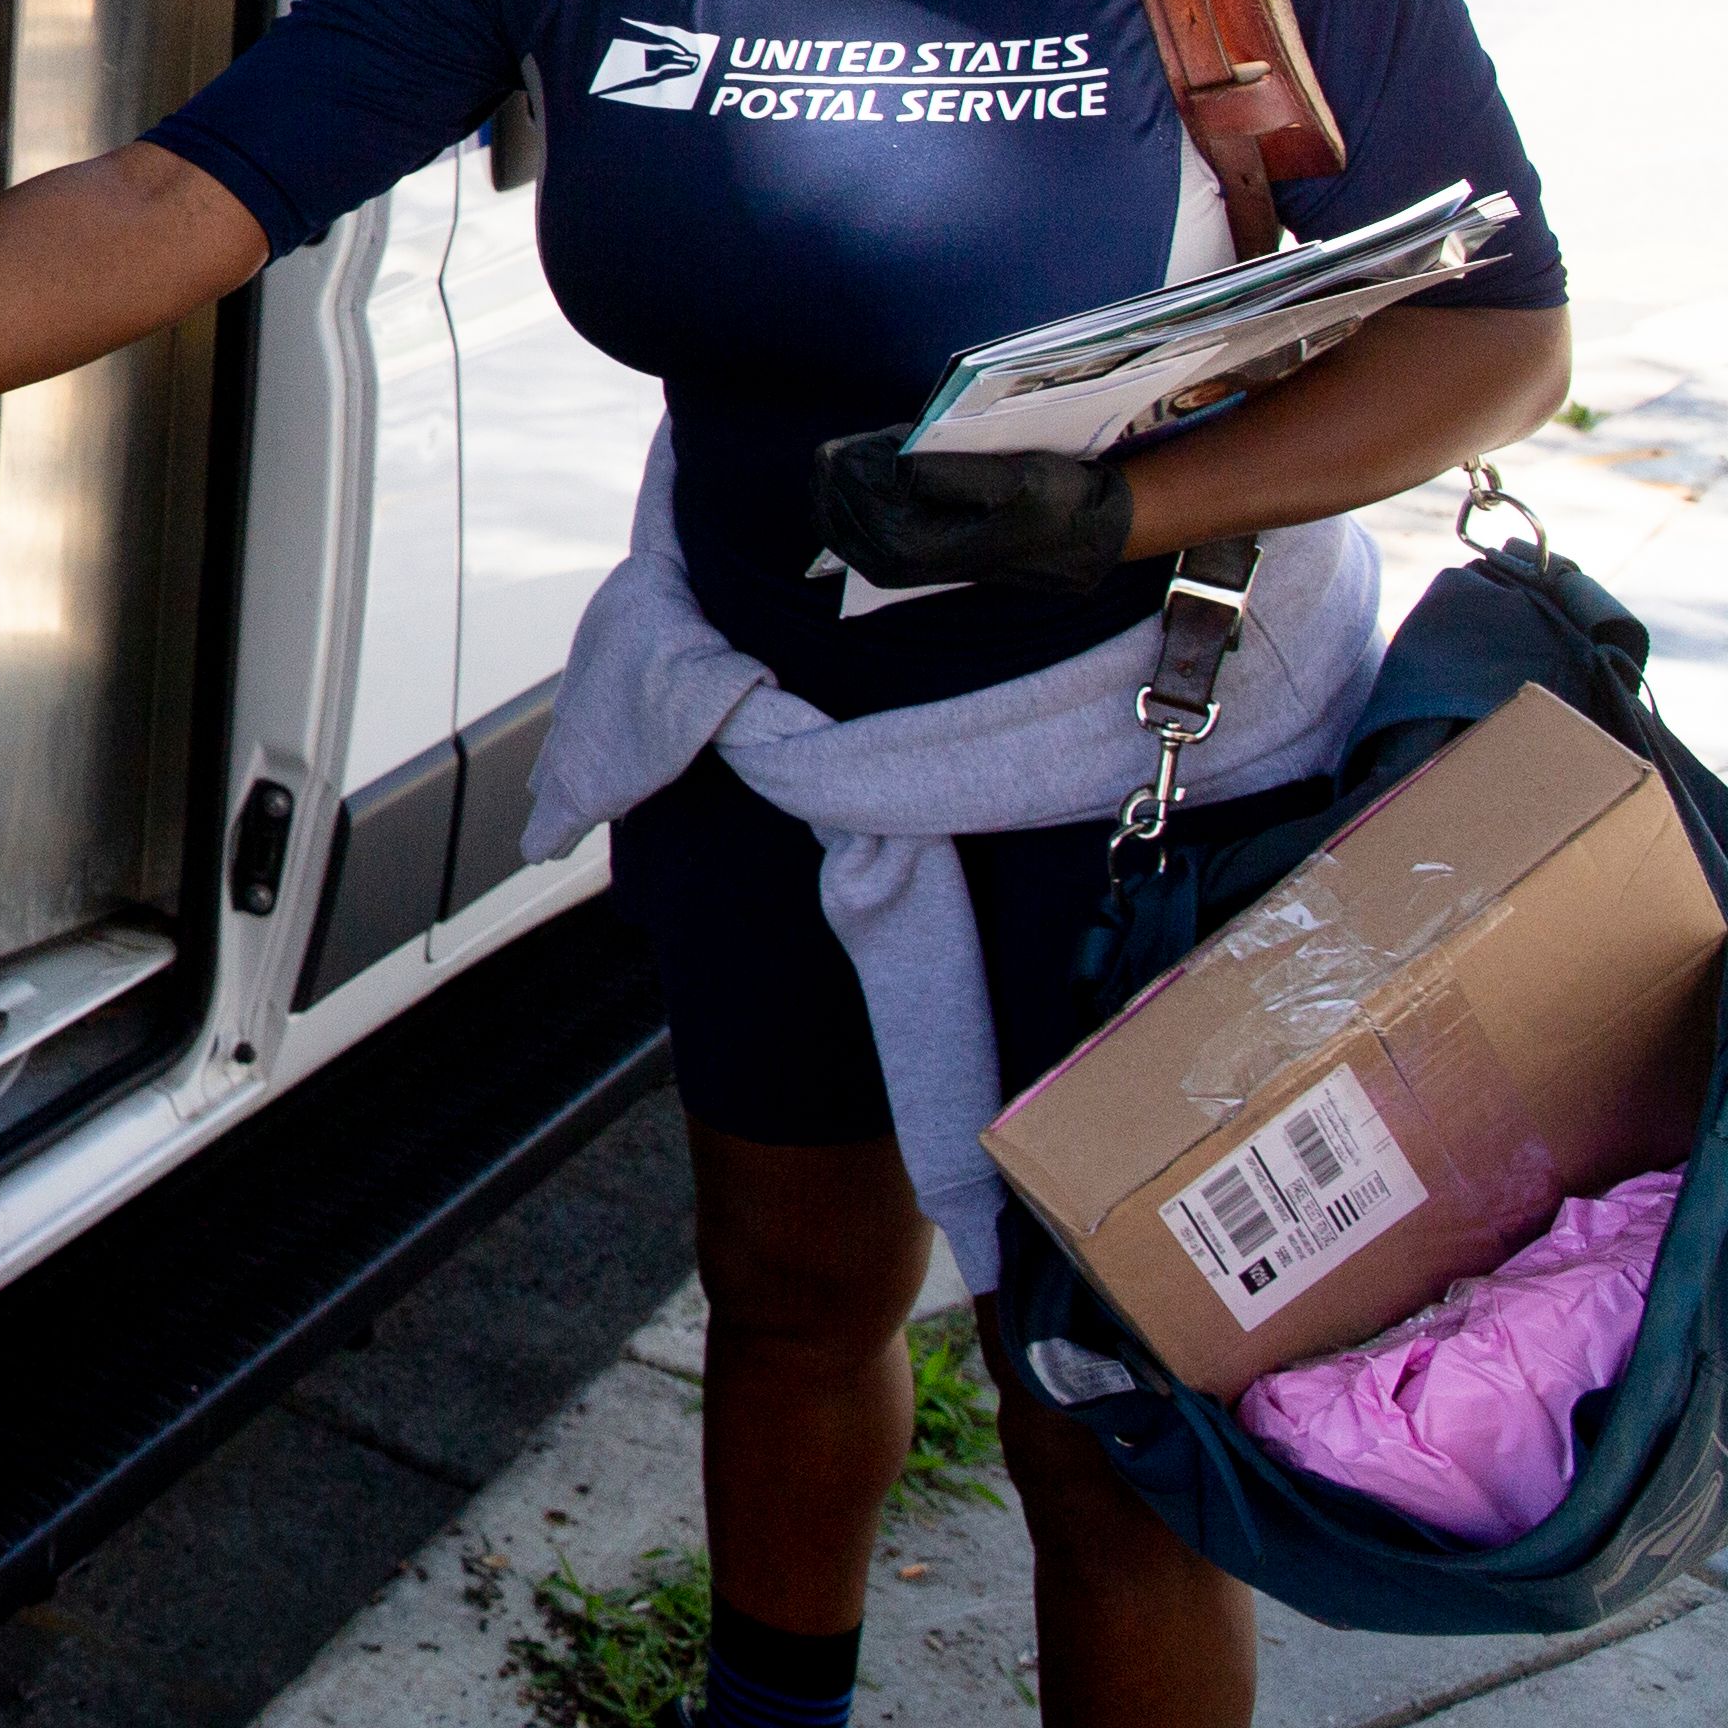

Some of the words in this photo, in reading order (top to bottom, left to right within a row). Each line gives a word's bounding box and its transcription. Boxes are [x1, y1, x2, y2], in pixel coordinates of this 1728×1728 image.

[729, 37, 906, 73] UNITED
[911, 33, 1089, 74] STATES
[709, 86, 884, 122] POSTAL
[895, 81, 1108, 123] SERVICE
